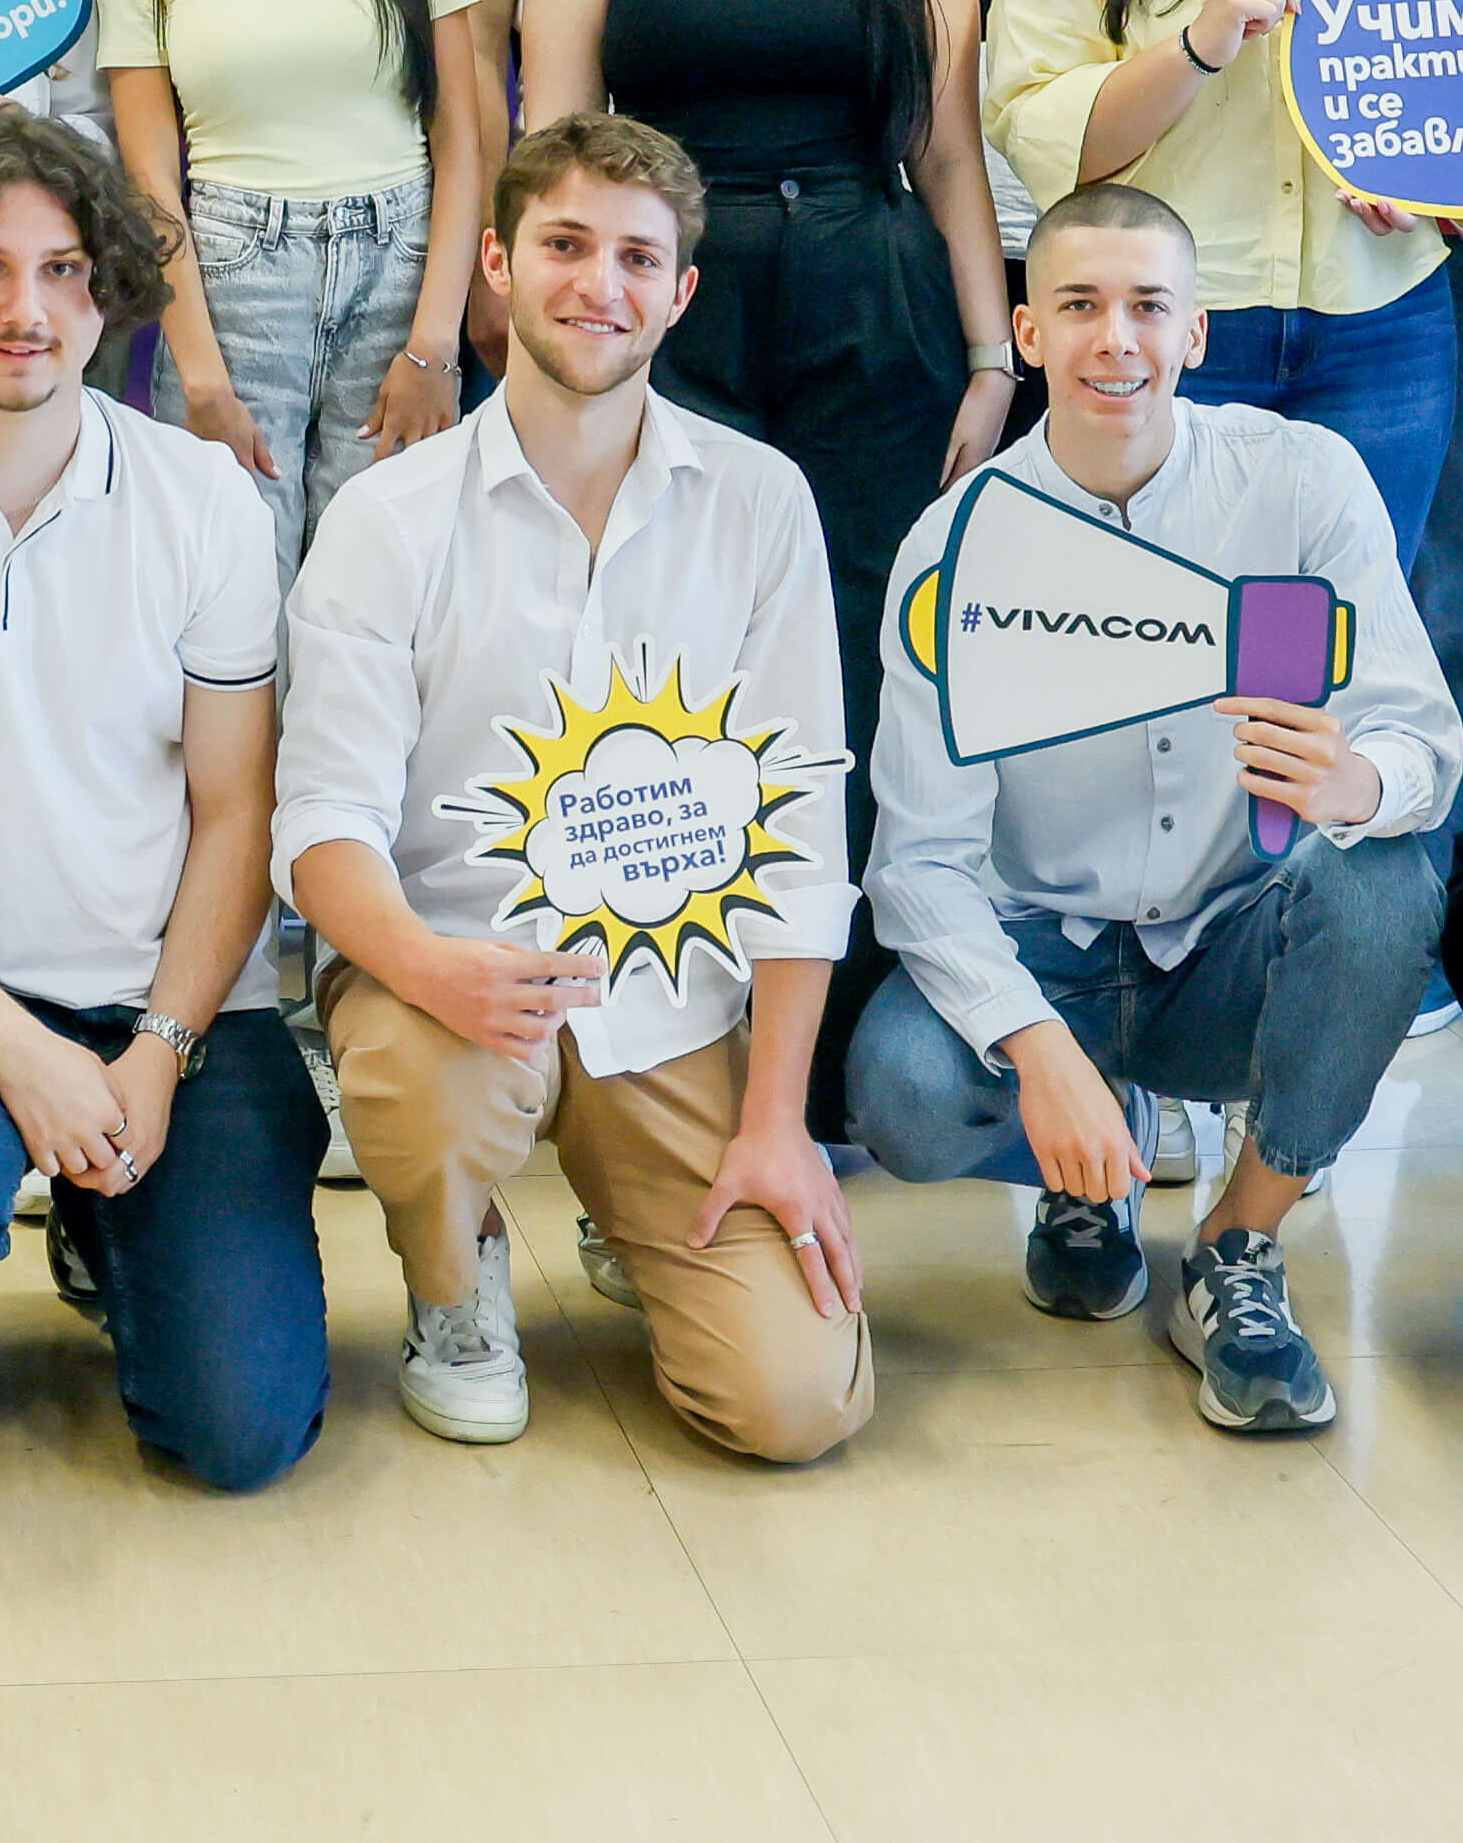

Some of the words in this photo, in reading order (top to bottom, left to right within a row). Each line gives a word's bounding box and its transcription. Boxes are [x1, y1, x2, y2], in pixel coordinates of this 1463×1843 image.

[1323, 92, 1349, 120] и
[1358, 88, 1404, 118] се
[960, 601, 1217, 647] #VIVACOM
[559, 776, 693, 817] Работим
[564, 809, 673, 844] здраво,
[678, 800, 708, 822] за
[569, 850, 598, 870] да
[602, 824, 726, 863] достигнем
[622, 839, 727, 883] върха!
